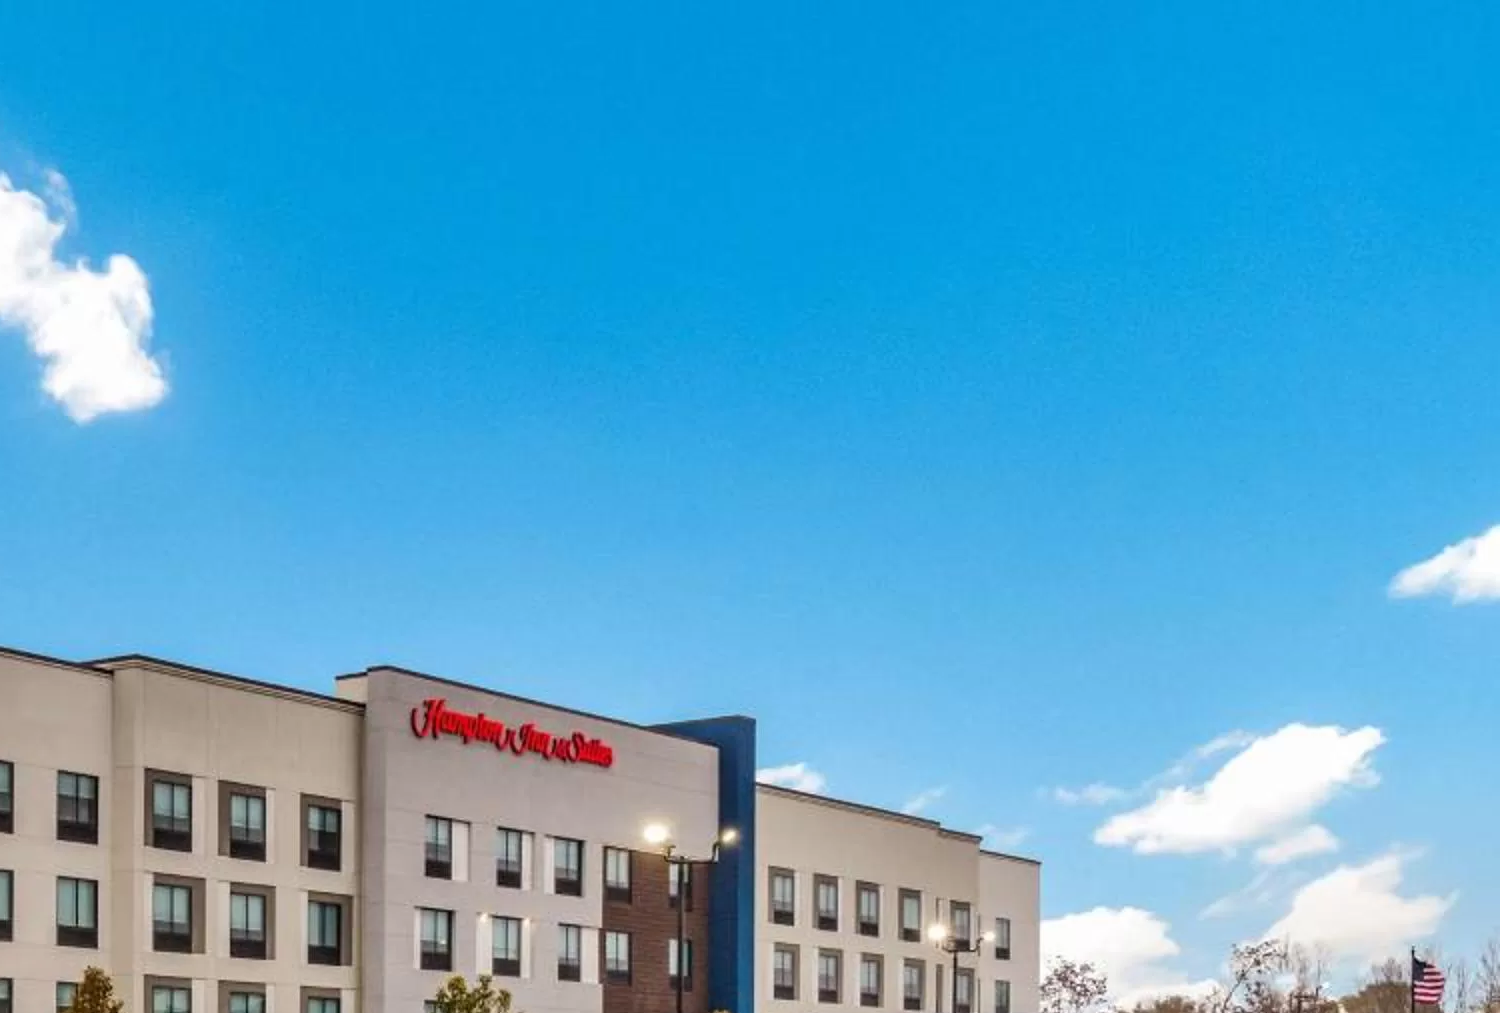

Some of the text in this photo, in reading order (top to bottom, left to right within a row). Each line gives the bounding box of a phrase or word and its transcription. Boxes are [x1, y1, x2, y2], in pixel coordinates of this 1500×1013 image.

[410, 697, 510, 751] Hampton
[509, 722, 557, 761] Inn
[566, 731, 613, 768] Suites
